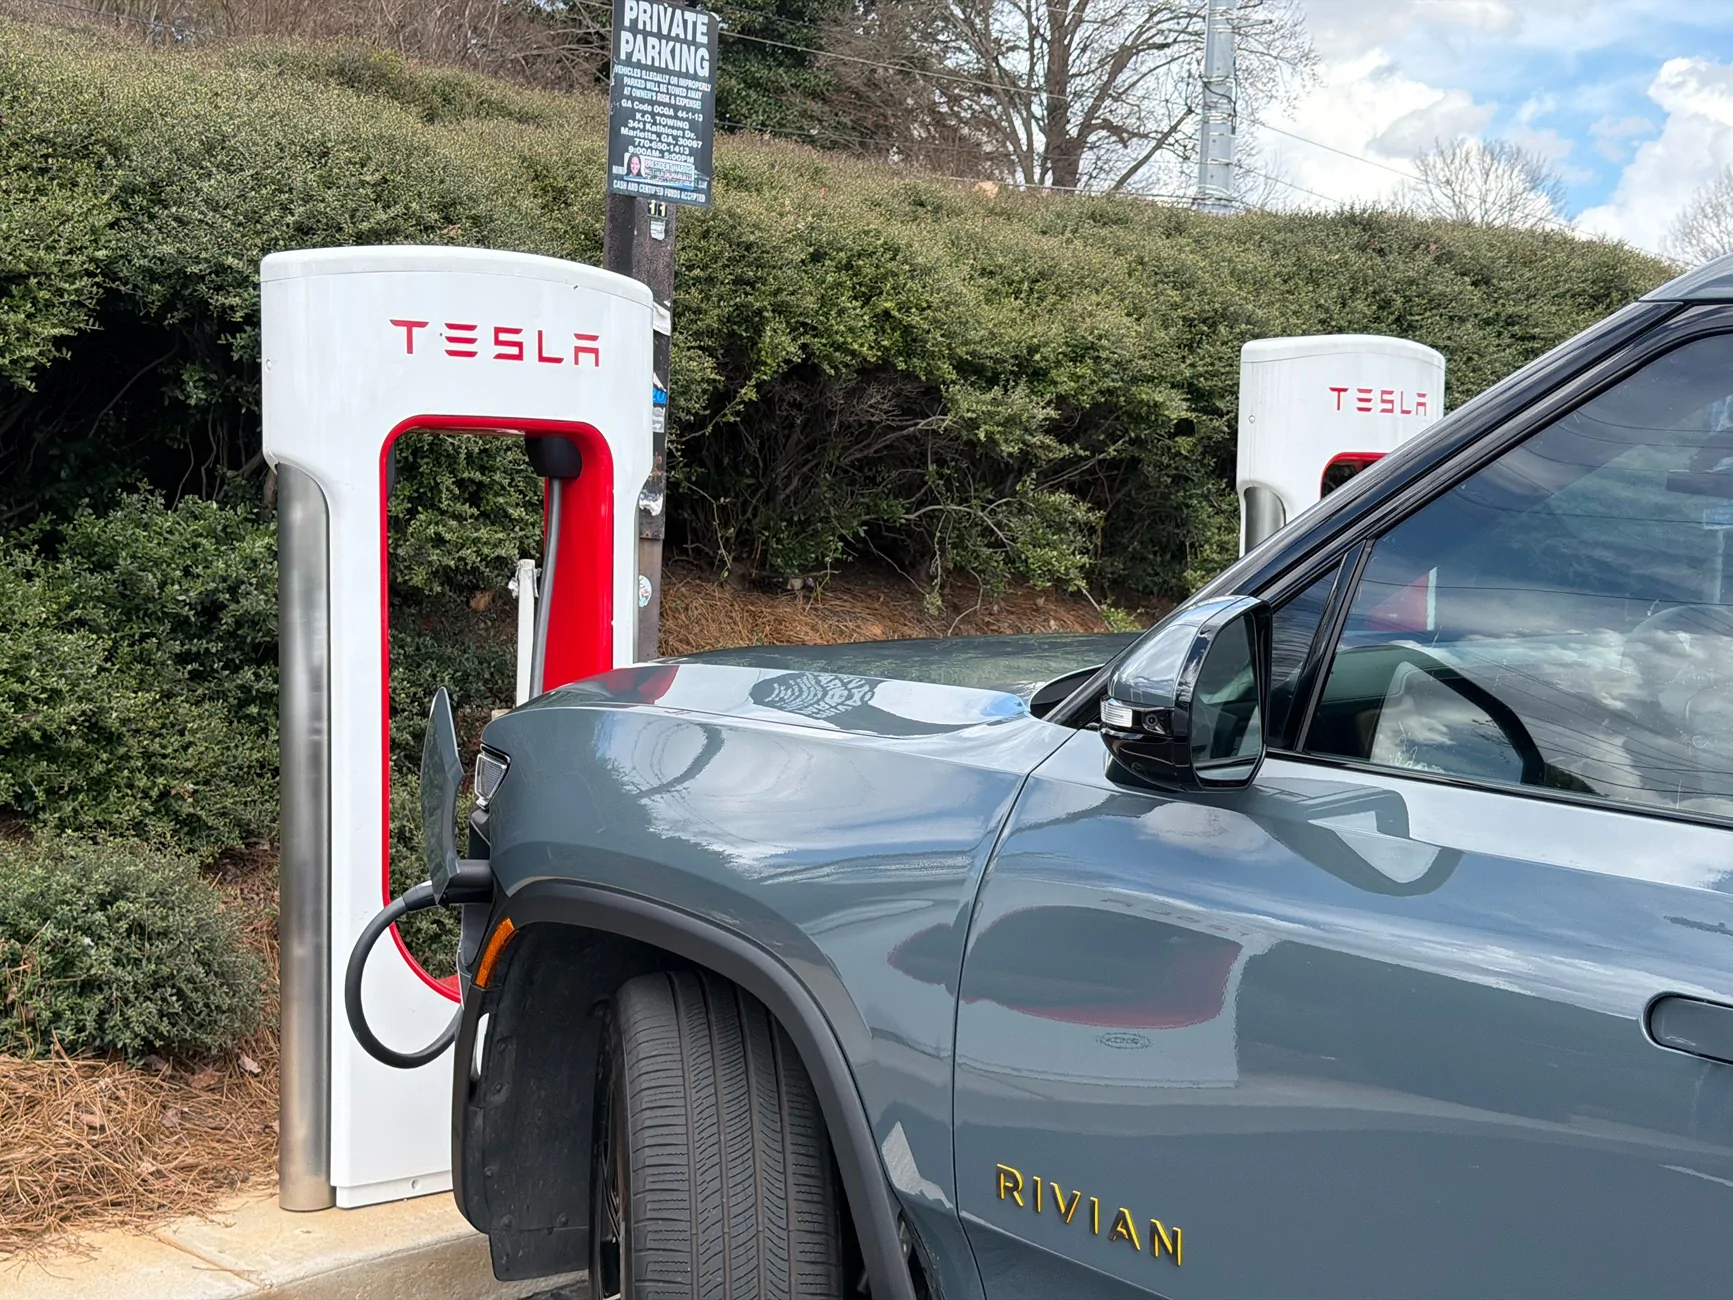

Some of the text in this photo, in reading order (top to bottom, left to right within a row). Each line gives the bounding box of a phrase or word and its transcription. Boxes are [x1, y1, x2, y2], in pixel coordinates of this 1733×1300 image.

[624, 0, 708, 44] PRIVATE
[620, 31, 710, 77] PARKING
[615, 65, 711, 92] VEHICLES ILLEGALLY OR IMPROPERLY
[624, 77, 702, 100] PARKED WILL BE TOWED AWAY
[624, 86, 632, 95] AT
[632, 88, 656, 100] OWNER'S
[657, 93, 670, 102] RISK
[621, 99, 703, 122] GA Code OCGA 44-1-13
[636, 112, 690, 129] K.O. TOWING
[621, 127, 702, 149] Marietta, GA. 30067
[628, 120, 696, 139] 344 Kathleen Dr.
[634, 138, 689, 155] 770-650-1413
[664, 152, 694, 164] 5:00PM
[613, 180, 627, 190] CASH
[628, 182, 638, 192] AND
[639, 184, 664, 196] CERTIFIED
[665, 188, 680, 199] FUNDS
[681, 191, 705, 203] ACCEPTED
[649, 199, 666, 217] 11
[389, 319, 600, 367] TESLA
[1328, 386, 1427, 416] TESLA
[995, 1163, 1183, 1267] RIVIAN
